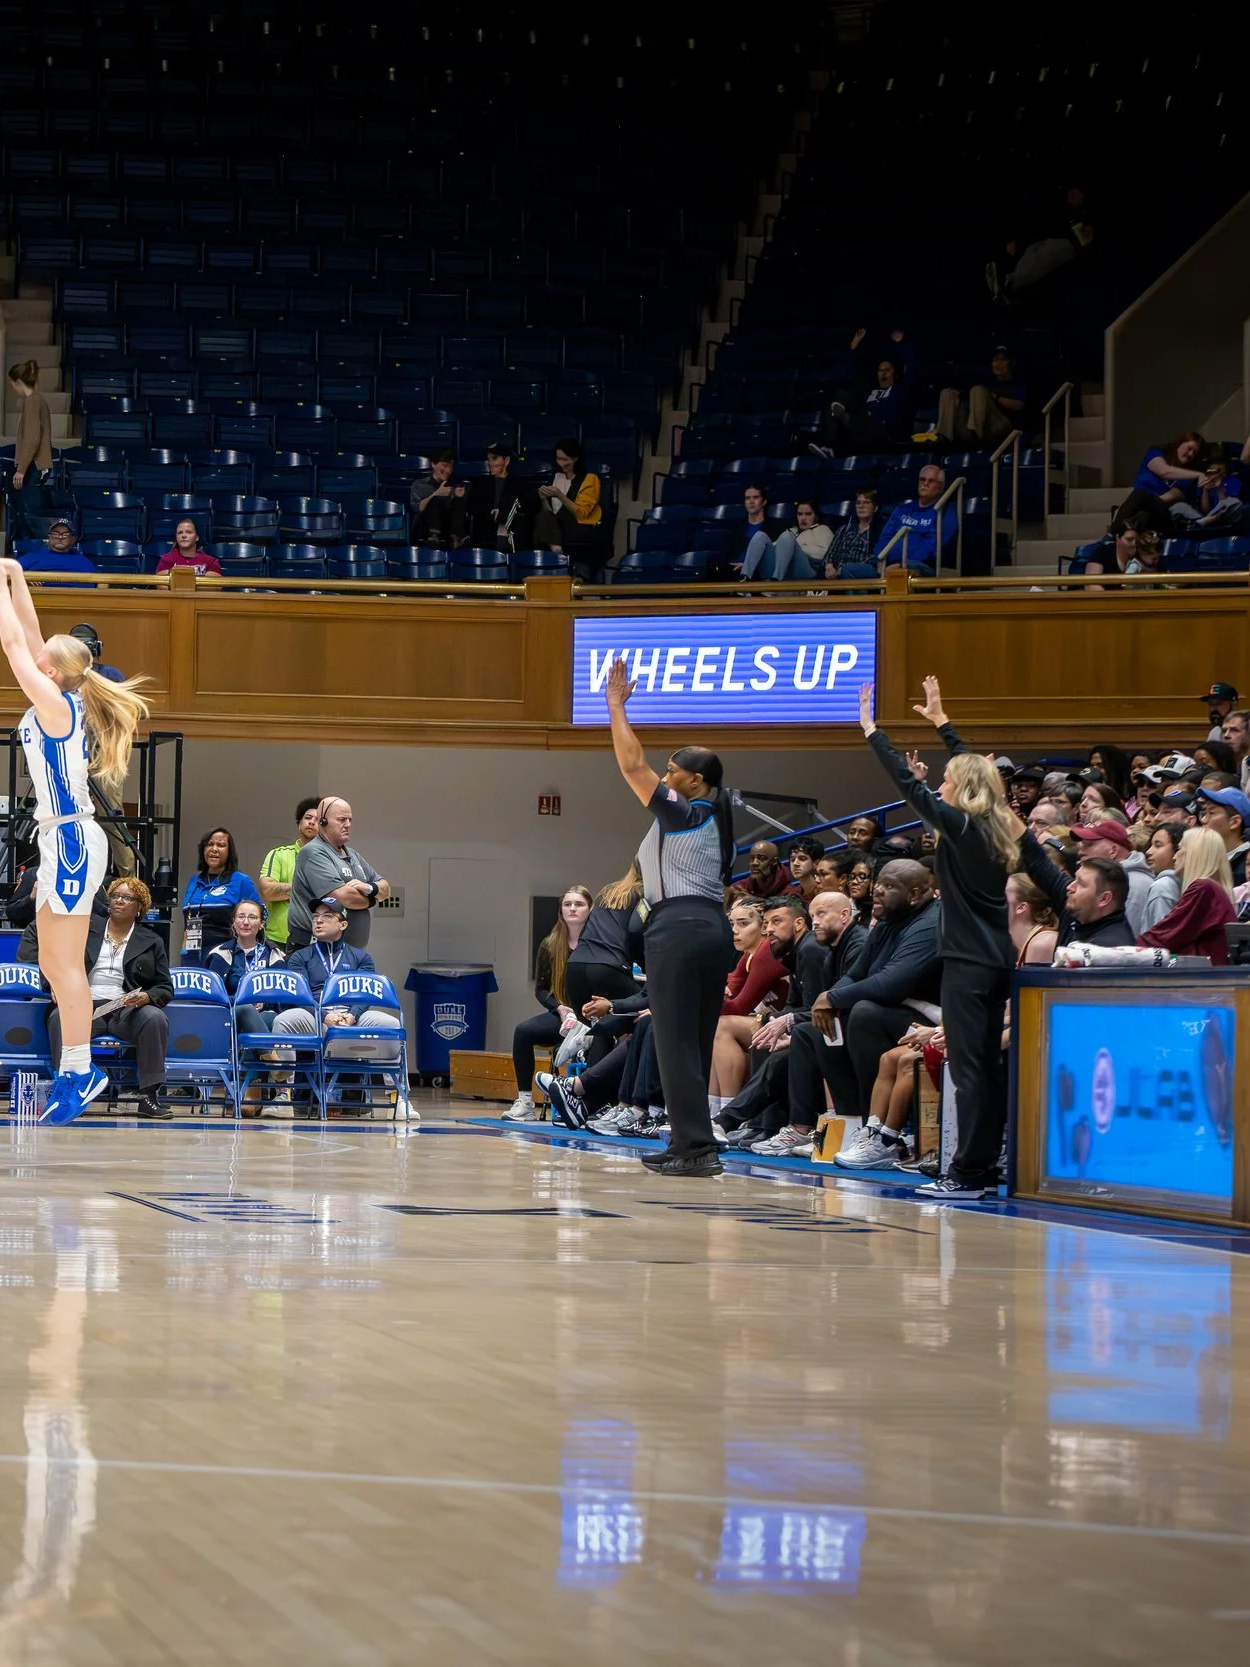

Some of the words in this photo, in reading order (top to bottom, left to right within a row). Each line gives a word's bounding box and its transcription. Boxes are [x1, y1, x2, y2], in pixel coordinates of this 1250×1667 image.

[589, 645, 780, 693] WHEELS
[793, 644, 859, 690] UP
[251, 974, 297, 996] DUKE
[338, 976, 383, 1000] DUKE
